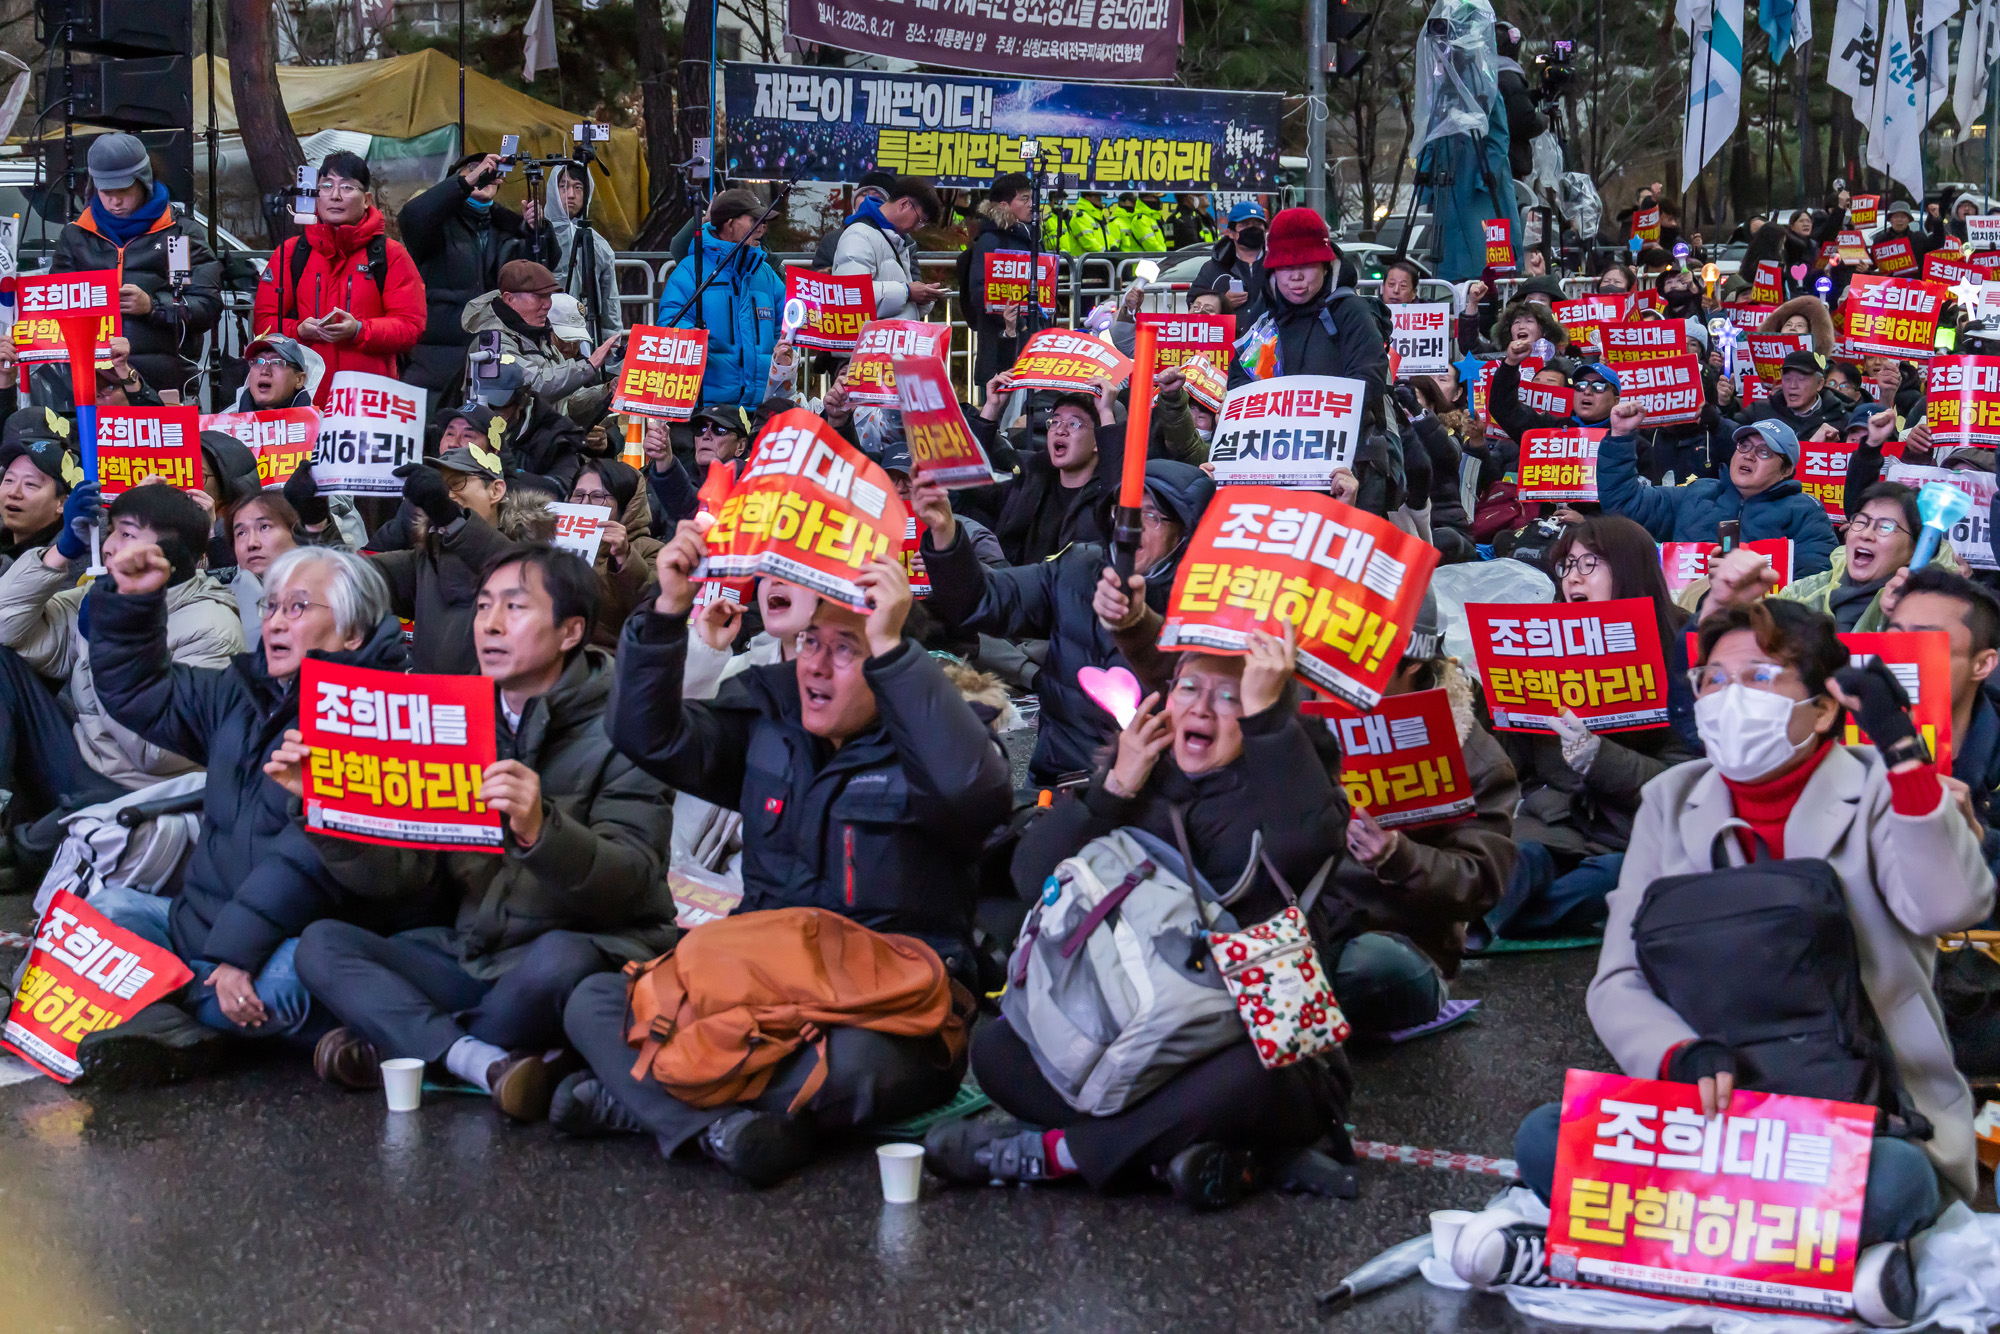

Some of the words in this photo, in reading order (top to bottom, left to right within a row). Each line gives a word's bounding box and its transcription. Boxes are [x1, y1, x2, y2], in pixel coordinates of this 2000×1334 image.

[817, 2, 834, 26] 일시
[906, 23, 926, 43] 장소
[934, 27, 974, 50] 대통령실
[974, 32, 987, 52] 앞
[995, 35, 1016, 56] 주최
[753, 72, 854, 123] 재판이
[860, 79, 993, 130] 개판이다!
[877, 129, 1027, 178] 특별재판부
[1095, 138, 1212, 182] 설치하라!
[1852, 198, 1874, 209] 희대를
[1852, 211, 1876, 224] 하라!
[1971, 231, 2000, 241] 설치하
[992, 260, 1047, 280] 조희대를
[1487, 246, 1511, 264] 하라!
[1973, 255, 2000, 268] 조희대
[1755, 268, 1775, 286] 대를
[1930, 261, 1983, 285] 조희대를
[22, 281, 108, 312] 조희대를
[795, 276, 862, 306] 조희대를
[1751, 286, 1779, 304] 하라!
[1860, 283, 1936, 313] 조희대를
[1394, 312, 1444, 331] 재판부
[1558, 302, 1617, 324] 조희대를
[1850, 312, 1932, 344] 탄핵하라!
[13, 315, 115, 345] 탄핵!
[857, 329, 935, 356] 조희대를
[1608, 327, 1676, 347] 조희대를
[636, 335, 704, 366] 조희대를
[1028, 334, 1120, 369] 조희대를
[1393, 337, 1443, 358] 하라!
[624, 368, 701, 401] 탄핵하라!
[1617, 365, 1690, 391] 조희대를
[1931, 364, 2000, 393] 조희대
[1224, 389, 1353, 421] 특별재판부
[1518, 387, 1567, 414] 희대를
[97, 417, 184, 448] 조희대를
[906, 421, 973, 461] 하라!
[1211, 429, 1348, 462] 설치하라!
[1529, 437, 1600, 458] 조희대를
[1522, 464, 1597, 486] 탄핵하라
[706, 490, 889, 569] 탄핵하라!
[1213, 503, 1406, 601] 조희대를
[1179, 563, 1398, 673] 탄핵하라!
[1487, 617, 1637, 657] 조희대를
[1488, 663, 1657, 709] 탄핵하라!
[315, 681, 468, 746] 조희대를
[1326, 714, 1431, 756] 대를
[309, 746, 487, 813] 탄핵하라!
[1340, 755, 1456, 808] 하라!
[34, 906, 155, 1001] 조희대를
[17, 963, 123, 1044] 핵하라!
[1593, 1098, 1833, 1186] 조희대를
[1569, 1177, 1841, 1274] 탄핵하라!
